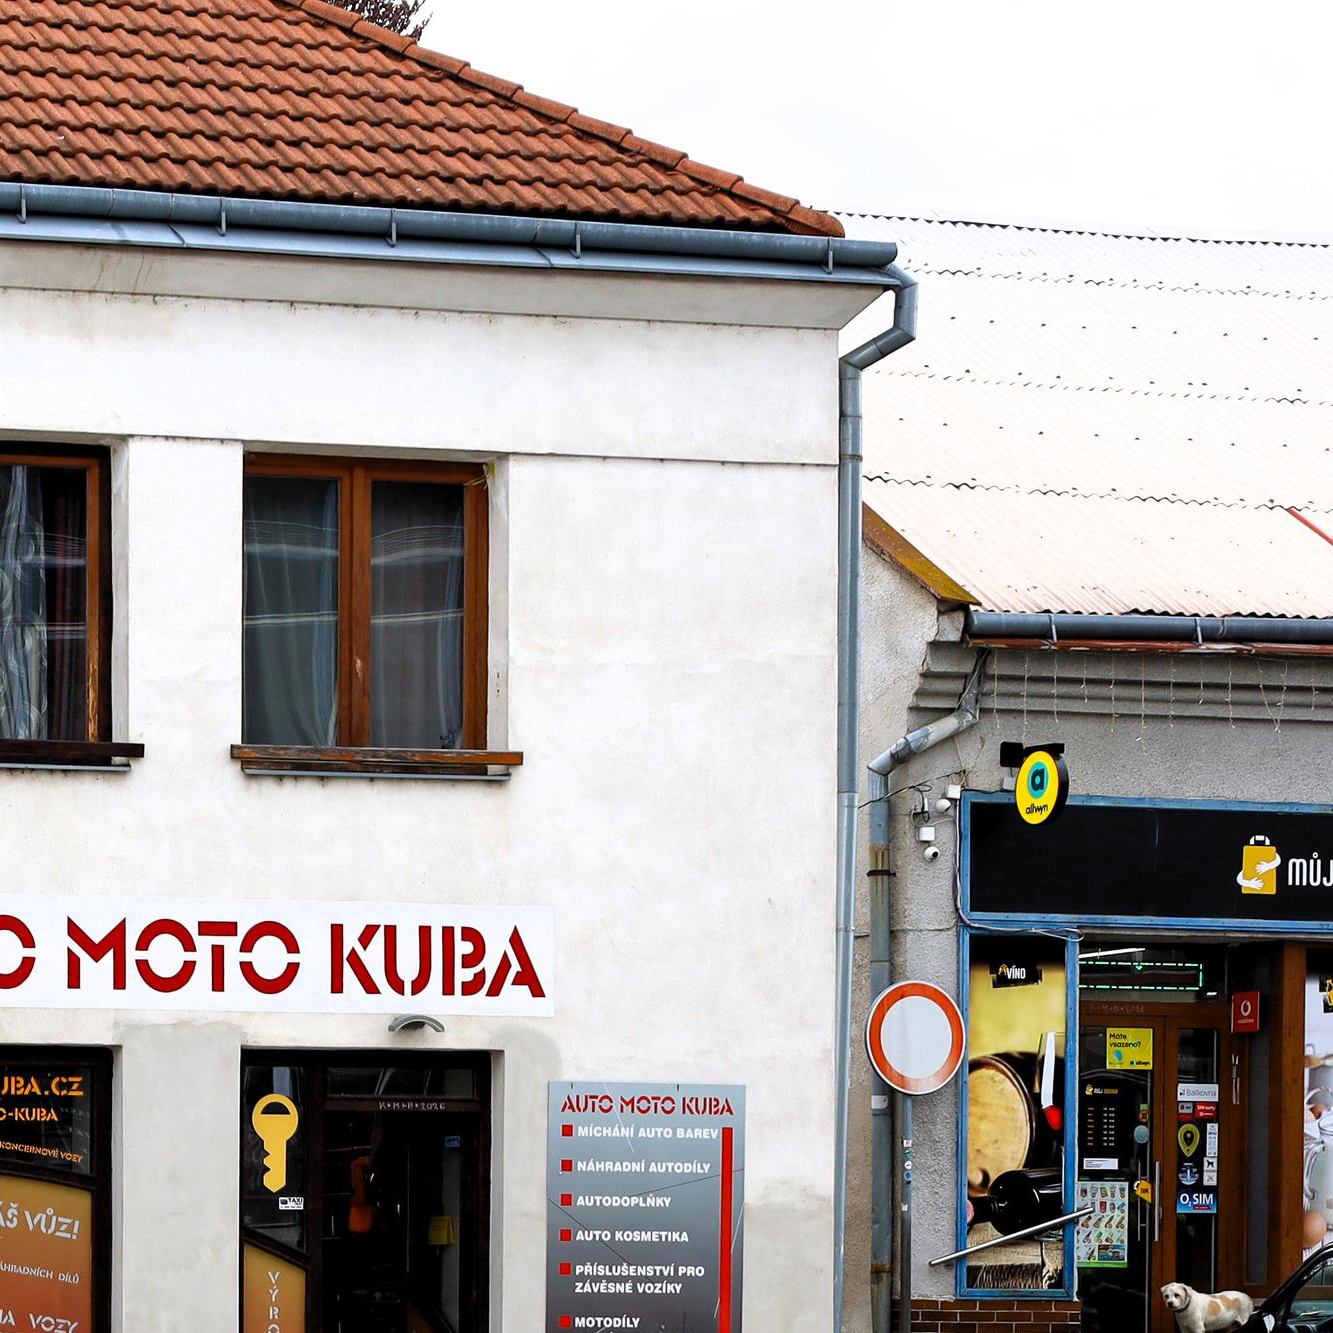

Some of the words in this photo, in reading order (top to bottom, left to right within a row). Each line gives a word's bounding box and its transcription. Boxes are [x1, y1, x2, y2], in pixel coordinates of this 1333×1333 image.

[1025, 803, 1049, 815] allwyn
[66, 916, 301, 995] MOTO
[329, 923, 546, 998] KUBA
[1006, 964, 1026, 980] VÍNO
[1109, 1032, 1127, 1040] Máte
[1109, 1040, 1142, 1048] vsazeno?
[561, 1094, 614, 1113] AUTO
[619, 1095, 676, 1115] MOTO
[682, 1097, 734, 1116] KUBA
[577, 1124, 635, 1138] MÍCHÁNÍ
[638, 1127, 673, 1139] AUTO
[676, 1128, 718, 1140] BAREV
[60, 1151, 84, 1163] VOZY
[577, 1159, 646, 1173] NÁHRADNÍ
[648, 1160, 711, 1174] AUTODÍLY
[576, 1193, 672, 1208] AUTODOPLŇKY
[1192, 1193, 1214, 1205] SIM
[24, 1207, 81, 1240] VŮZ!
[576, 1230, 611, 1242] AUTO
[614, 1230, 689, 1242] KOSMETIKA
[575, 1262, 675, 1276] PŘÍSLUŠENSTVÍ
[678, 1266, 705, 1277] PRO
[58, 1271, 80, 1284] DÍLŮ
[574, 1279, 633, 1294] ZÁVĚSNÉ
[636, 1280, 683, 1294] VOZÍKY
[574, 1314, 640, 1328] MOTODÍLY
